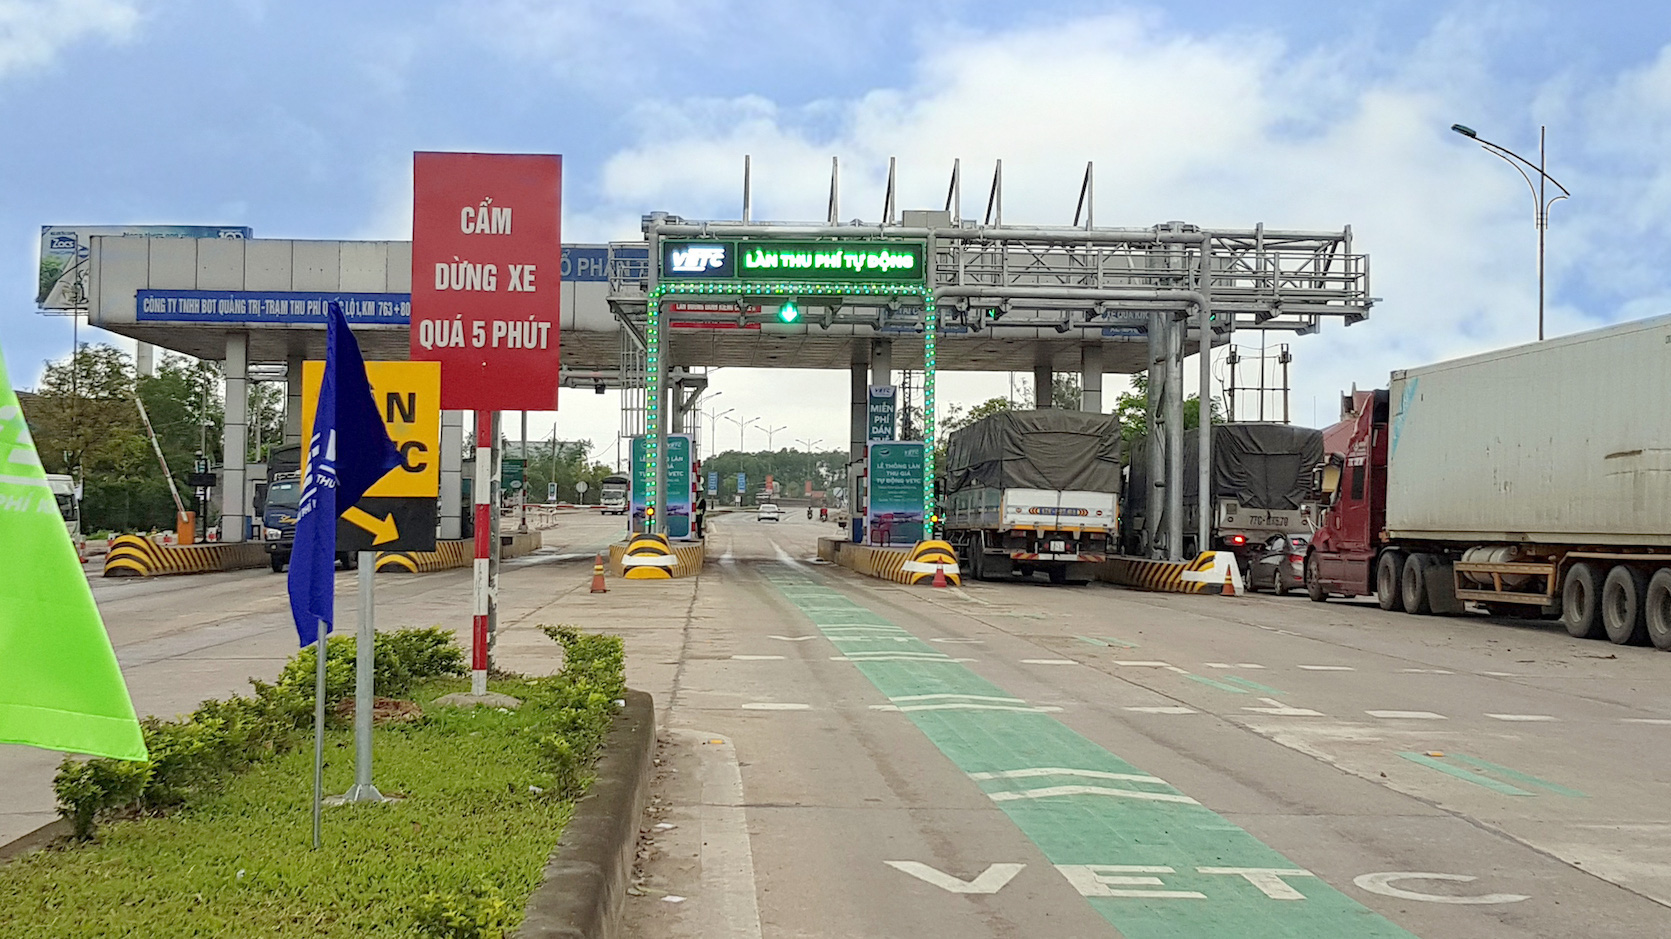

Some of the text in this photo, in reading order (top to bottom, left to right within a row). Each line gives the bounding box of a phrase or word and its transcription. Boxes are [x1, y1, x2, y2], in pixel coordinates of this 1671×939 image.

[460, 197, 512, 234] CẤM
[745, 248, 914, 272] LÀN THU PHÍ TỰ ĐỘNG
[435, 256, 537, 292] DỪNG XE
[143, 295, 166, 313] CÔNG
[167, 298, 178, 313] TY
[179, 298, 200, 314] TNHH
[201, 299, 217, 314] BOT
[218, 294, 246, 316] QUẢNG
[290, 300, 305, 315] THU
[307, 296, 321, 315] PHÍ
[378, 301, 393, 317] 763
[419, 314, 551, 350] QUÁ 5 PHÚT
[872, 425, 891, 435] DÁN
[874, 414, 890, 424] PHÍ
